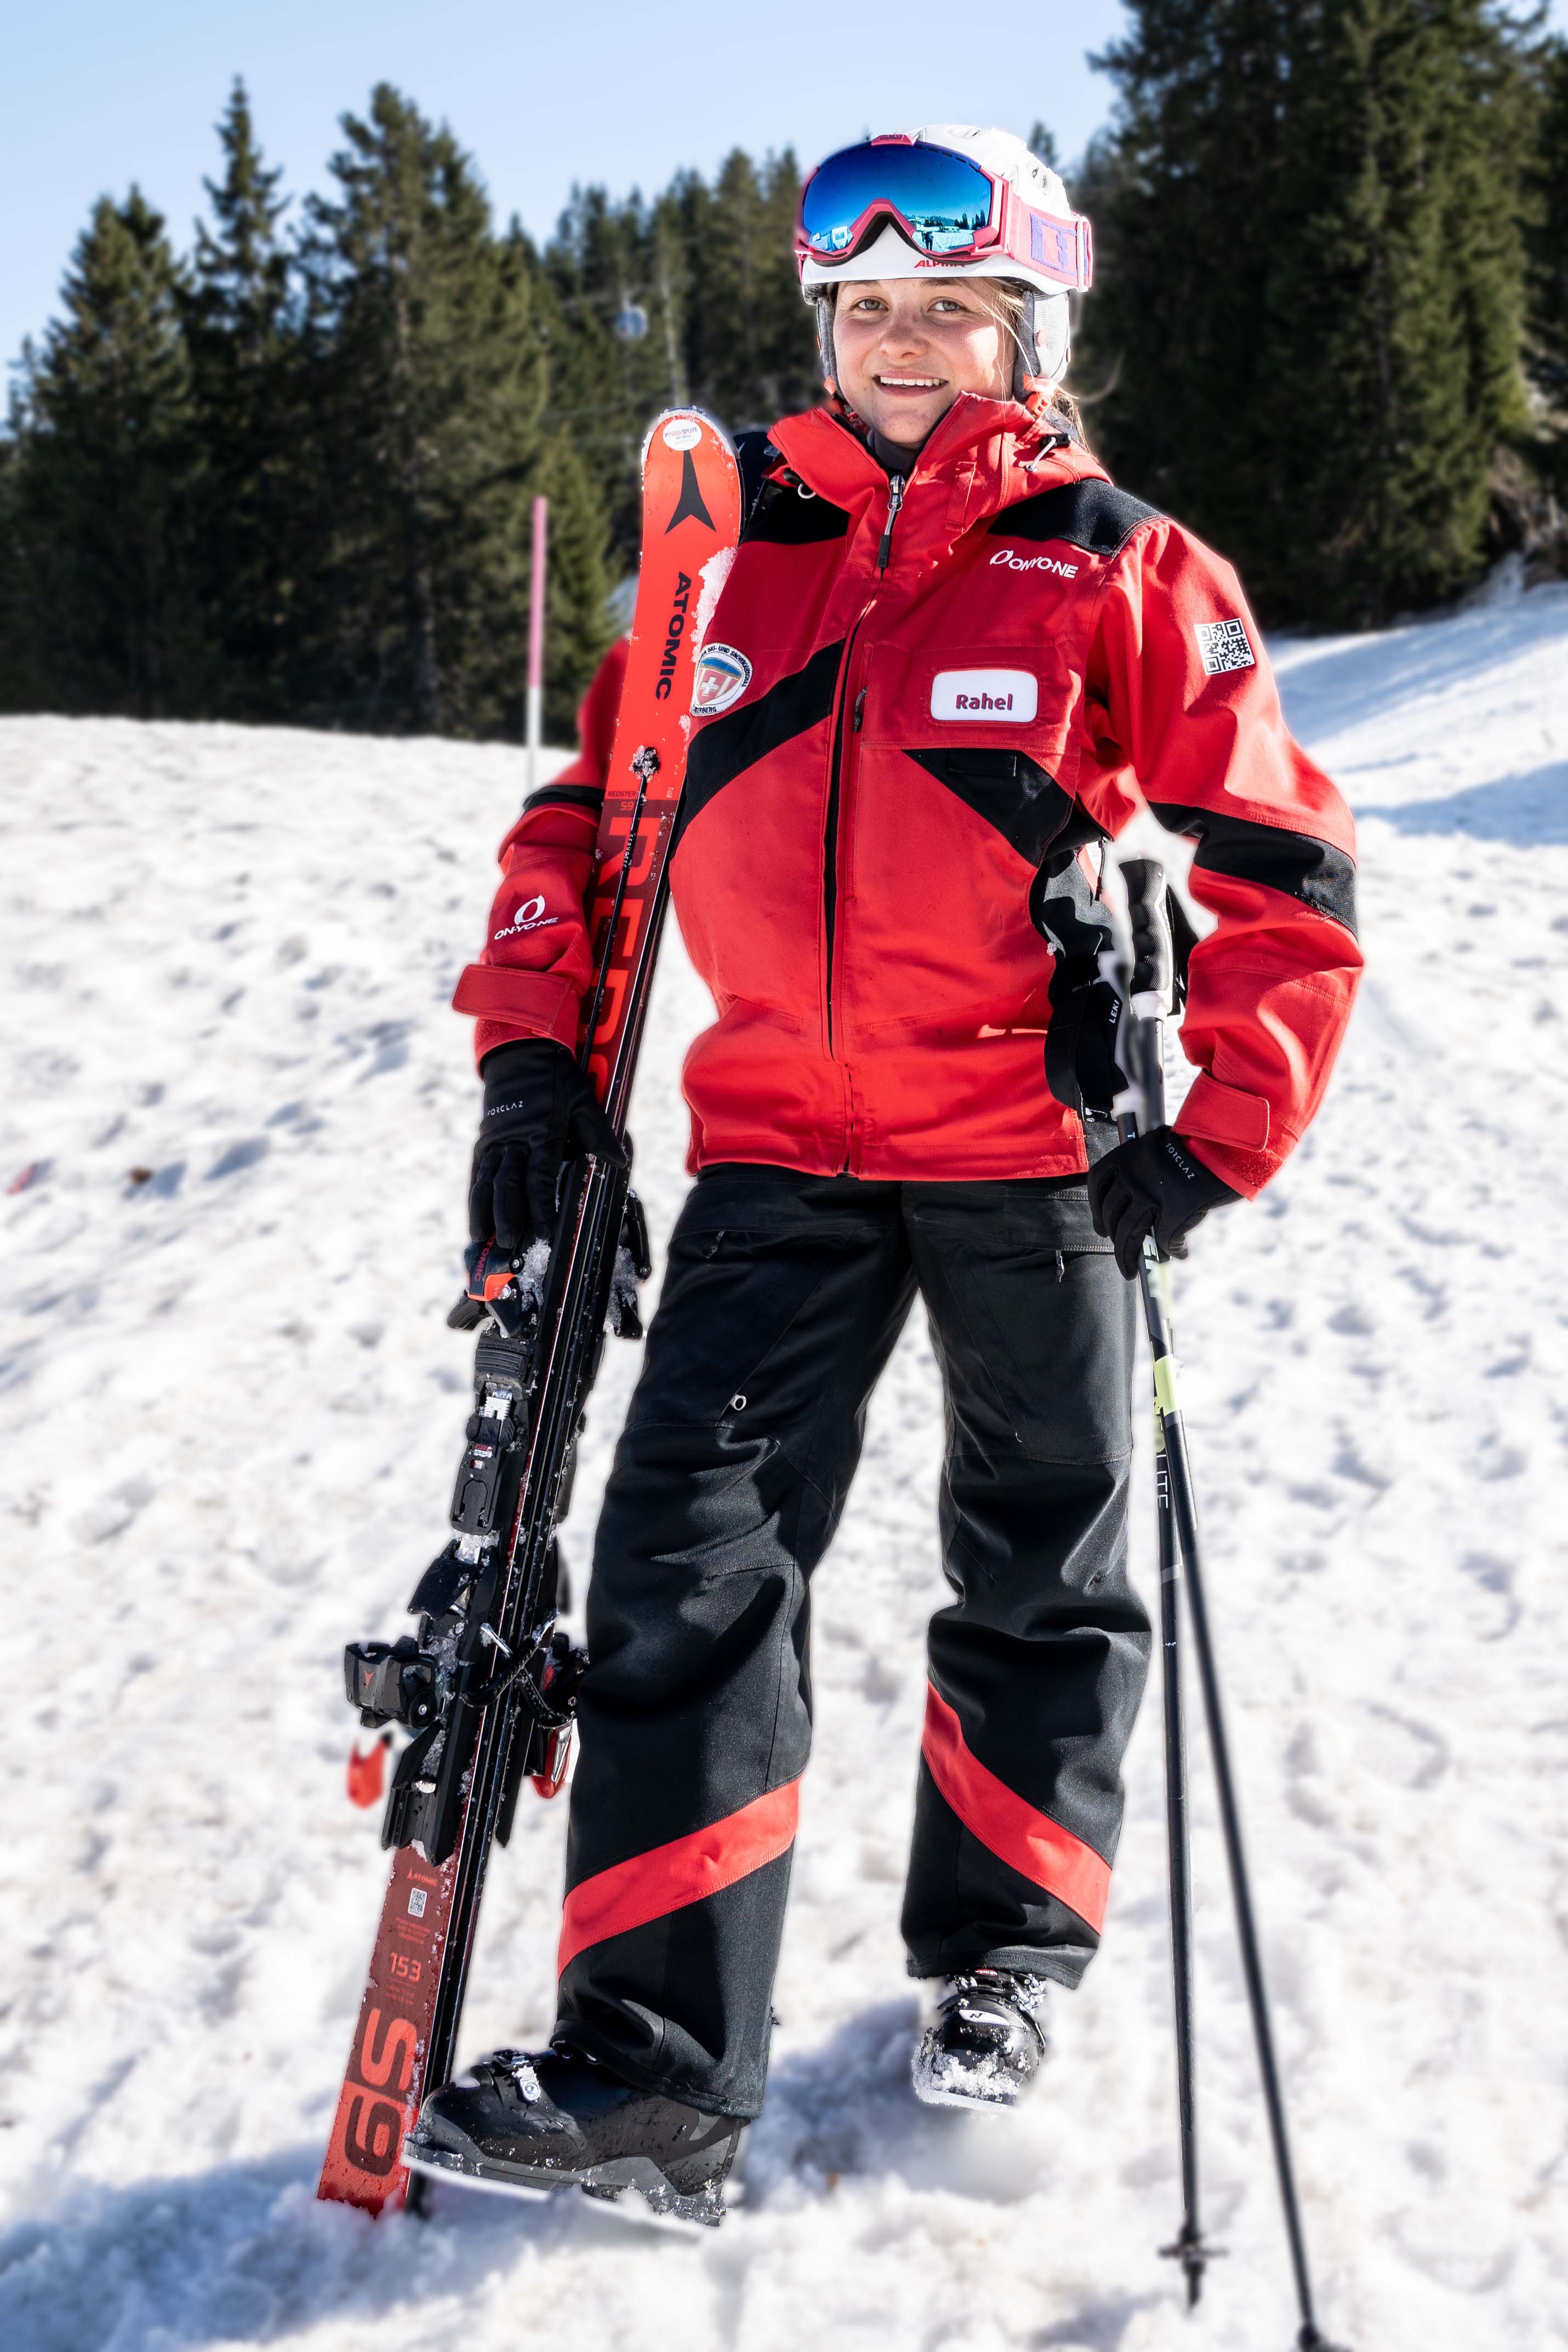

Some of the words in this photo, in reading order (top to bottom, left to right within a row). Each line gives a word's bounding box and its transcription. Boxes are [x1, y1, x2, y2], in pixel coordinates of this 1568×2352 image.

[655, 571, 692, 701] ATOMIC
[718, 646, 730, 654] UND
[955, 692, 1013, 711] Rahel
[620, 801, 635, 811] S9
[1109, 999, 1120, 1024] LEKI
[487, 1100, 523, 1118] FORCLAZ
[1166, 1143, 1196, 1180] FORCLAZ
[390, 1952, 421, 1983] 153
[345, 2007, 418, 2177] S9
